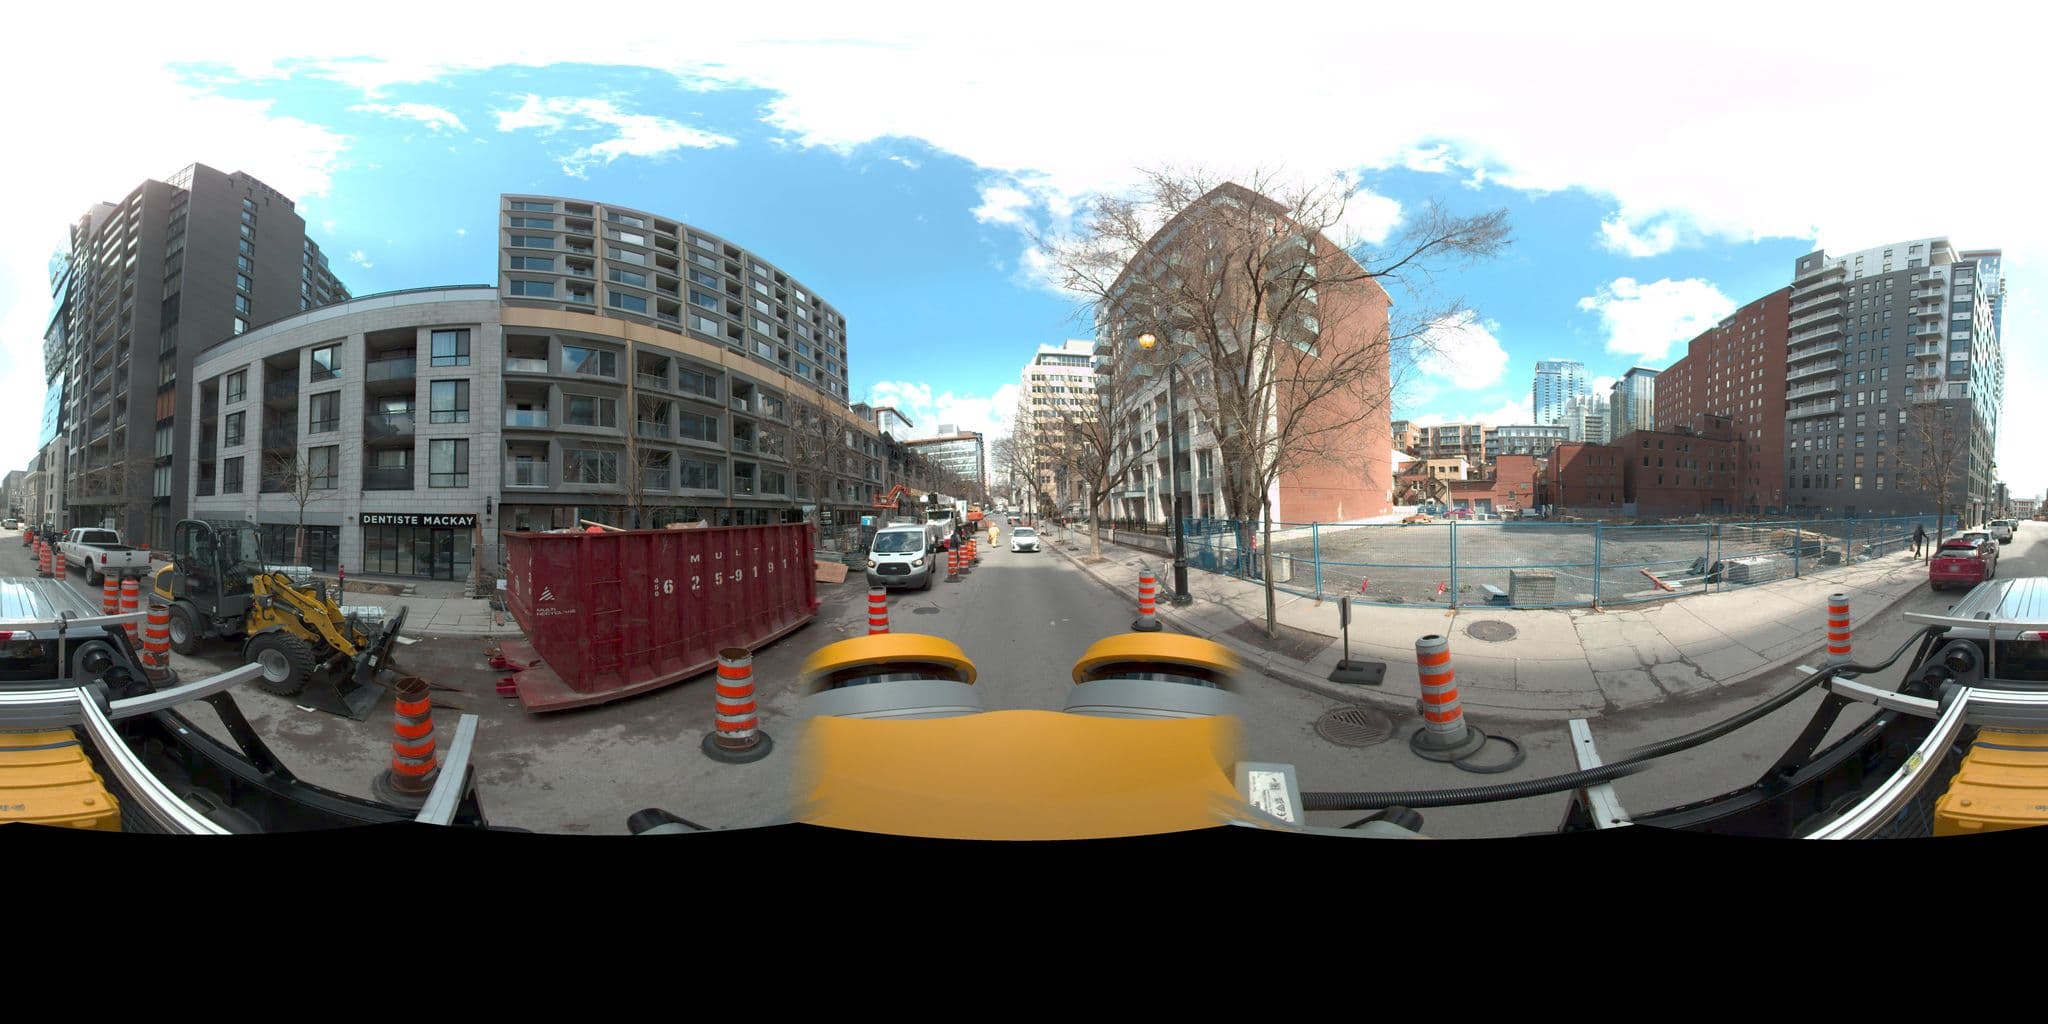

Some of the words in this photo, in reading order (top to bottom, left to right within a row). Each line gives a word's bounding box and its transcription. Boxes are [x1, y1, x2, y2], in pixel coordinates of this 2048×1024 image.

[363, 515, 418, 525] DENTISTE
[423, 516, 474, 526] MACKAY
[663, 558, 787, 594] 625-9191
